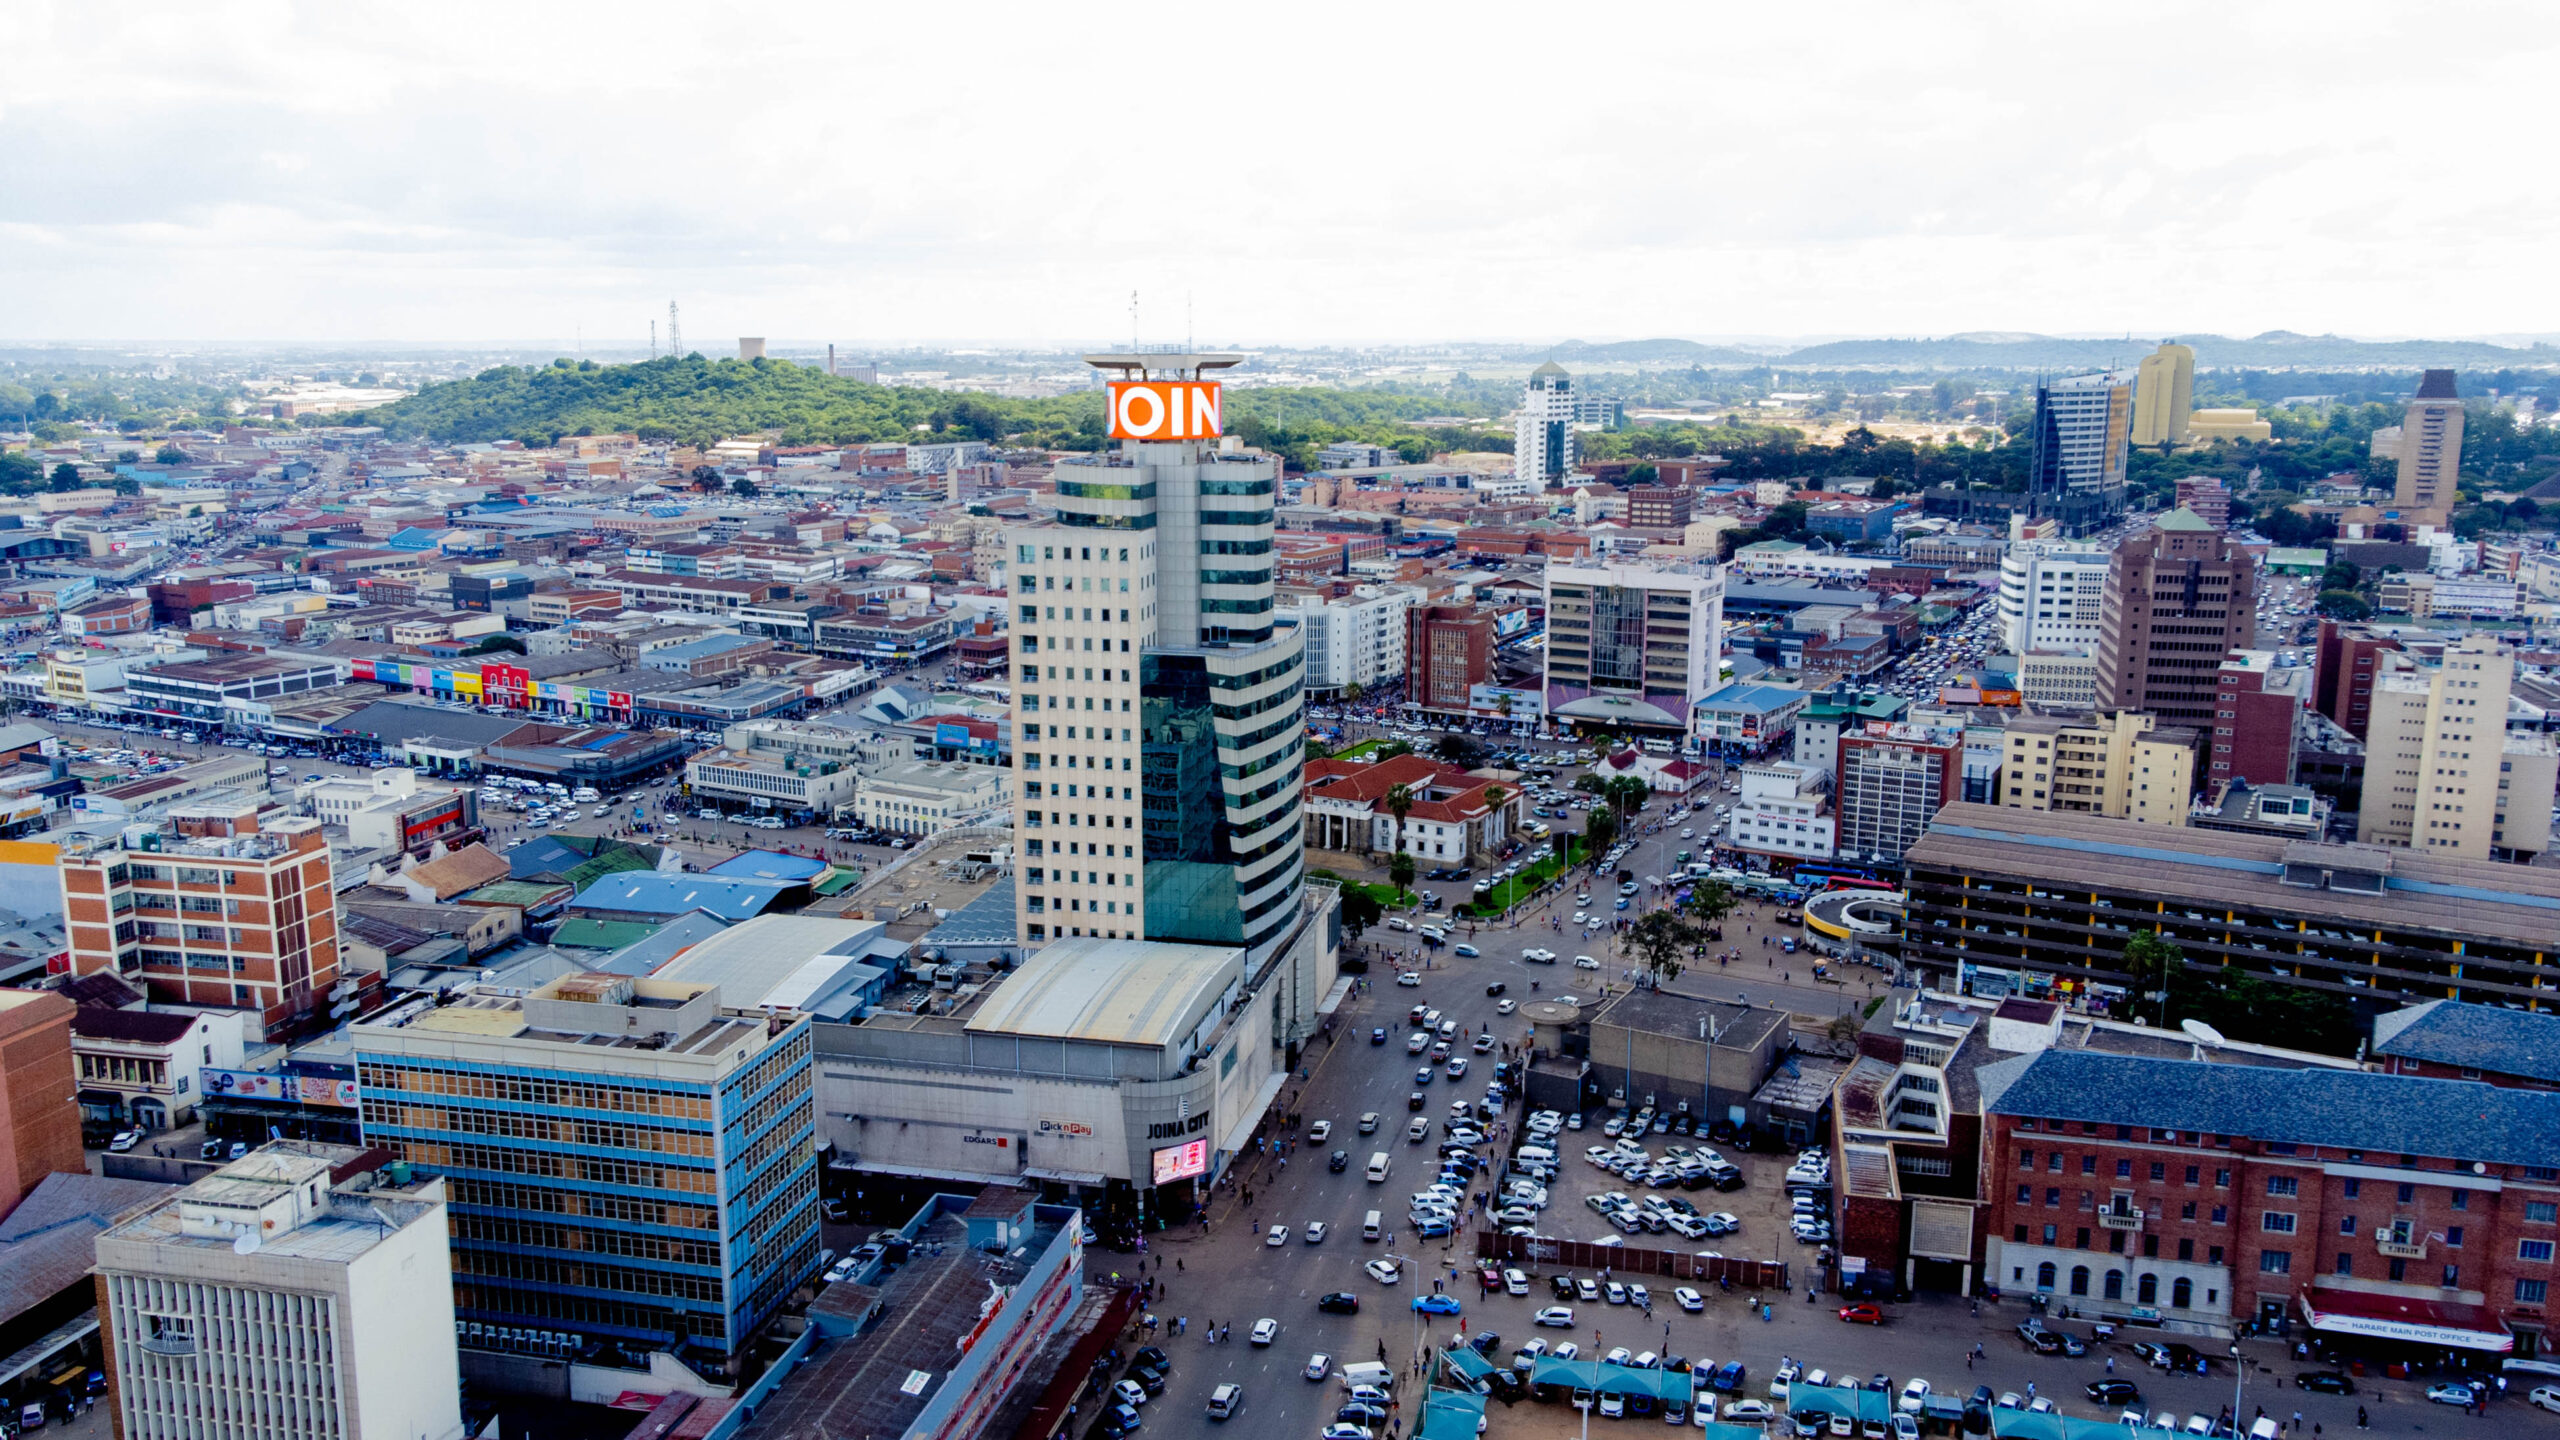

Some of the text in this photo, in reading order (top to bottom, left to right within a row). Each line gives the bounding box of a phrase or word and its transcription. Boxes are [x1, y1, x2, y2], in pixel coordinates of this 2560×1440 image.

[1107, 386, 1220, 437] JOIN
[1040, 1120, 1062, 1131] Pick
[1070, 1123, 1092, 1135] Pay
[1147, 1110, 1209, 1140] JOINA CITY
[963, 1135, 997, 1145] EDGARS
[2351, 1322, 2387, 1333] HARARE
[2390, 1326, 2413, 1336] MAIN
[2414, 1330, 2438, 1339] POST
[2439, 1332, 2472, 1343] OFFICE
